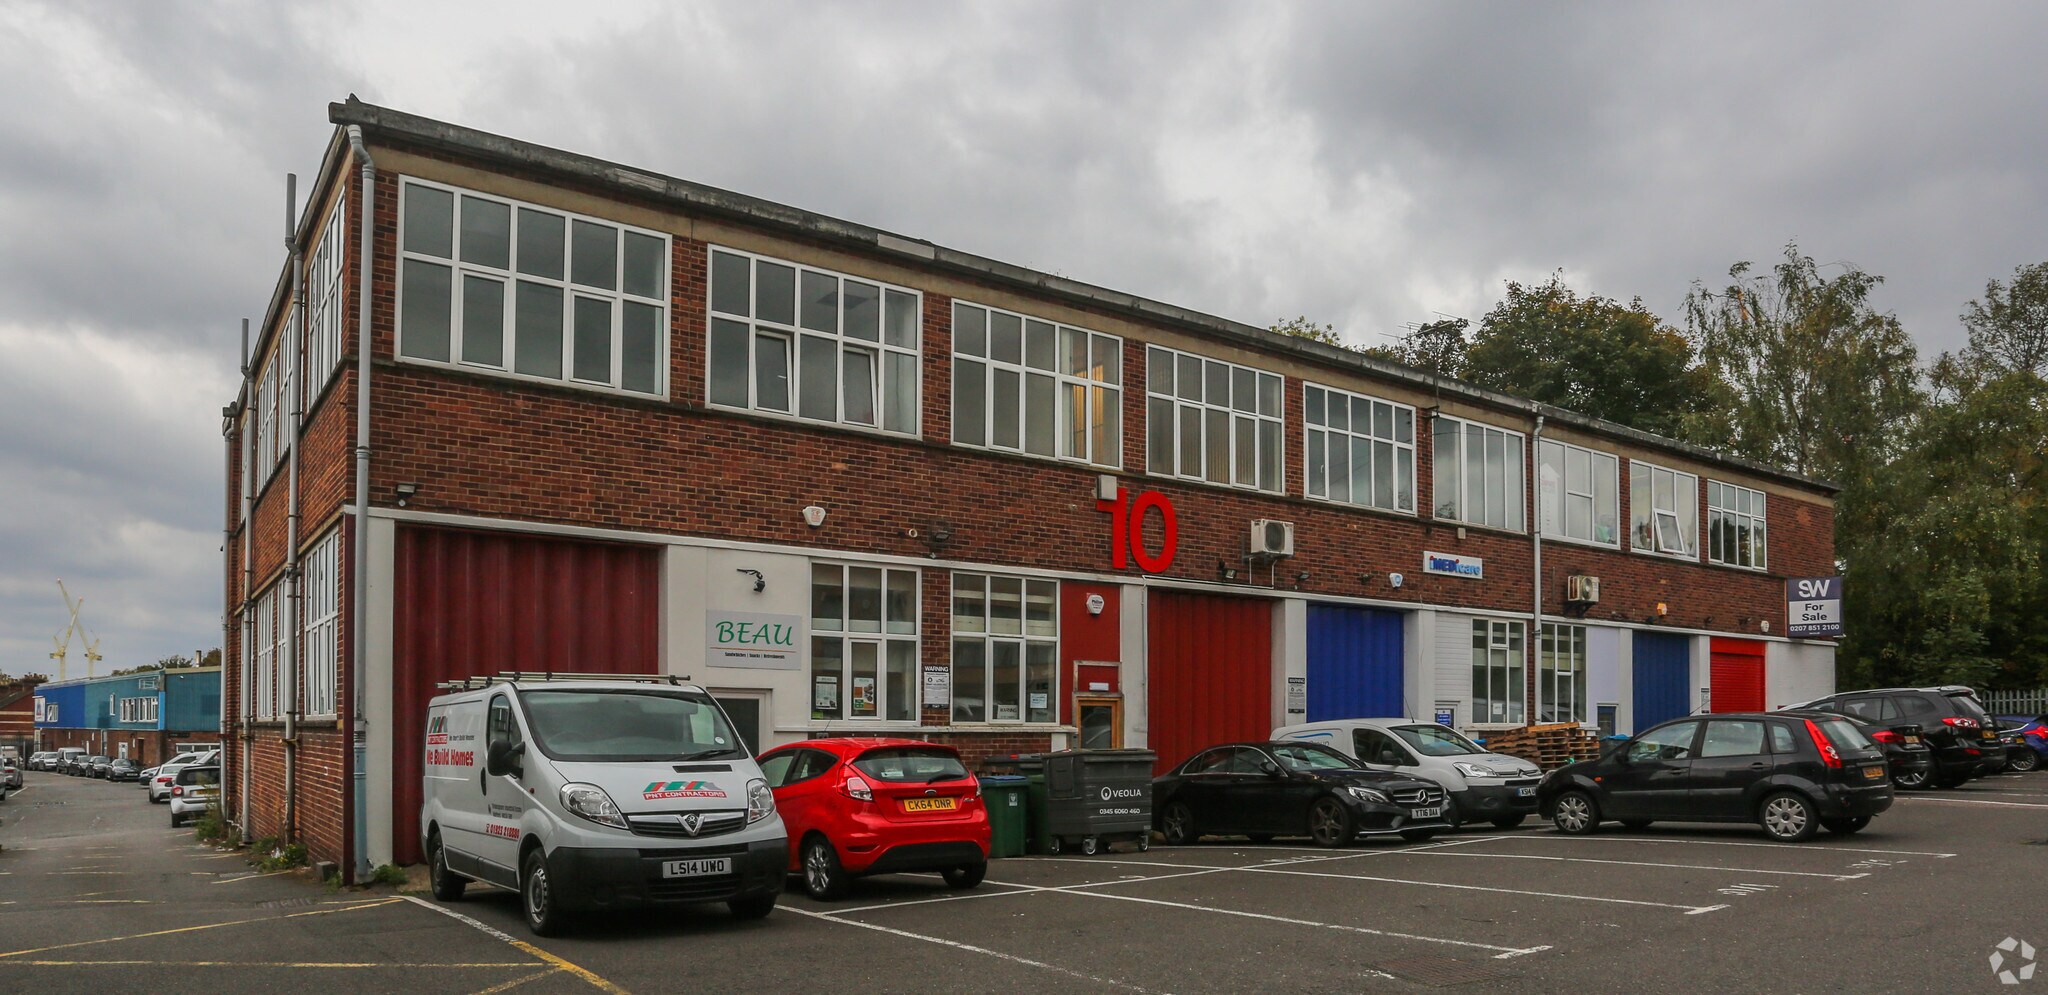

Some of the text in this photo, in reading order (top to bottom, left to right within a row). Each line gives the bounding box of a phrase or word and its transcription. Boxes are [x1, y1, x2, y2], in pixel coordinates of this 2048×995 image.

[1096, 487, 1178, 573] 10
[1799, 580, 1830, 597] SW
[1805, 603, 1824, 611] For
[1802, 613, 1827, 621] Sale
[716, 621, 793, 645] BEAU
[427, 749, 474, 766] We Build Homes
[1113, 789, 1142, 797] VEOLIA
[908, 800, 933, 810] CK64
[670, 860, 724, 875] LS14 UWO
